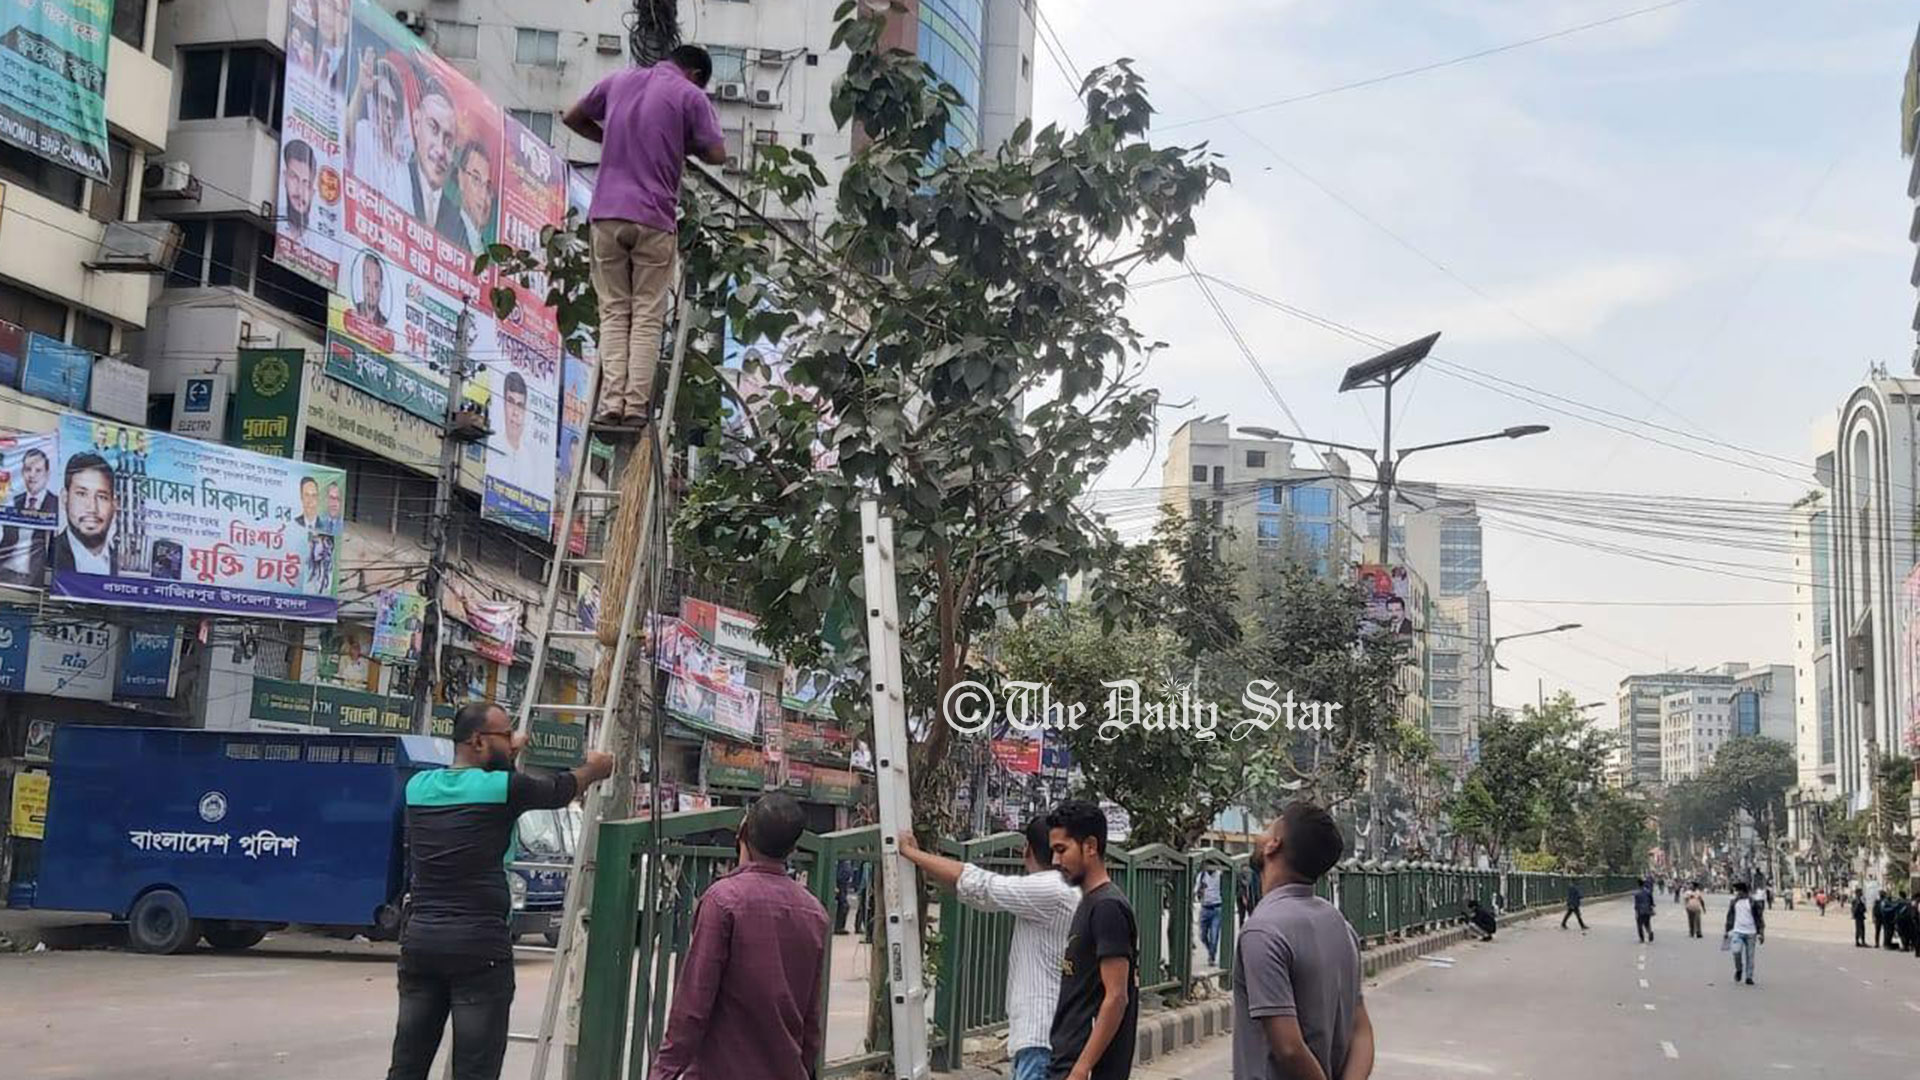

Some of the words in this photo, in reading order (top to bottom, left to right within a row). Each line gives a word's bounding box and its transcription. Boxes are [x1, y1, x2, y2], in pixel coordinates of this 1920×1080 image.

[178, 420, 211, 432] ELECTRO
[200, 478, 270, 521] সিকদার
[190, 542, 246, 583] মুক্তি
[256, 553, 301, 588] চাই
[544, 731, 578, 750] LIMITED
[129, 829, 231, 855] বাংলাদেশ
[239, 829, 301, 860] পুলিশ
